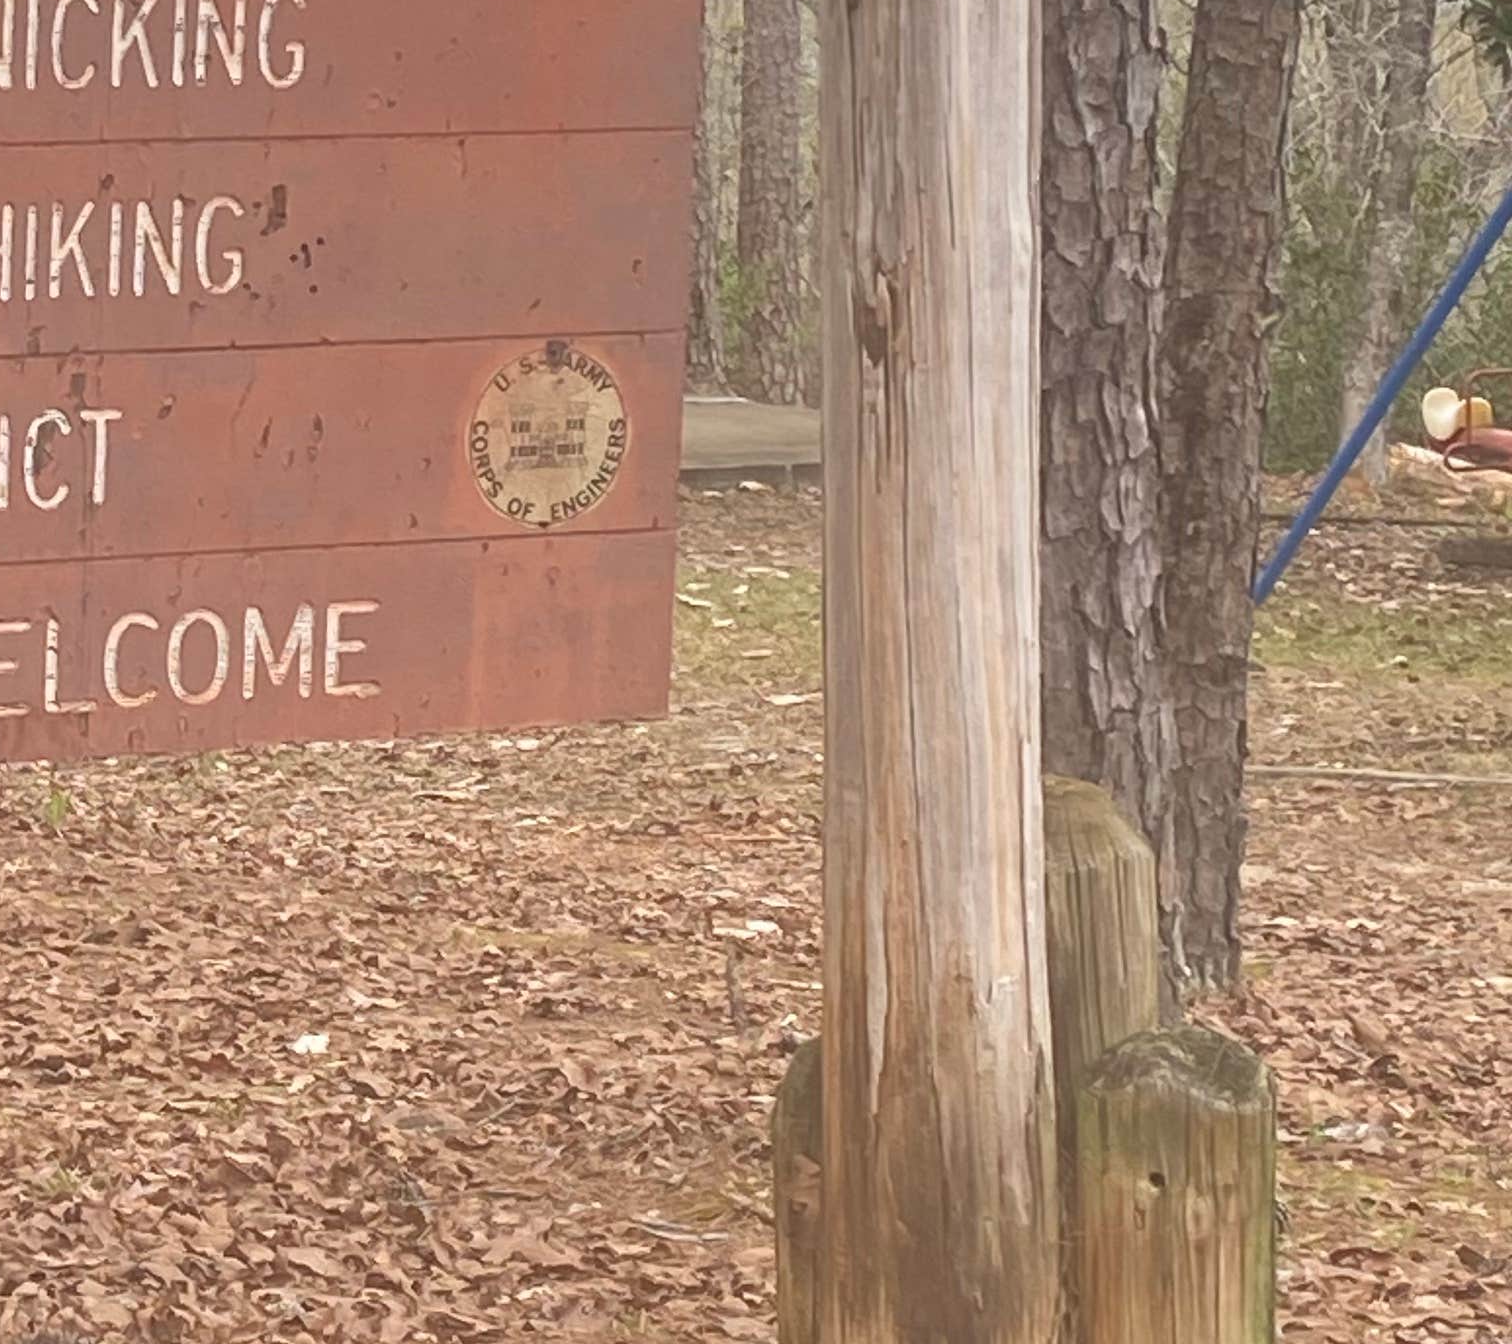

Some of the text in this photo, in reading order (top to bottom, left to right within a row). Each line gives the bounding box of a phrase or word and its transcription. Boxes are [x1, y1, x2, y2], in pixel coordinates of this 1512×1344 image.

[471, 417, 627, 521] CORPS OF ENGINEERS
